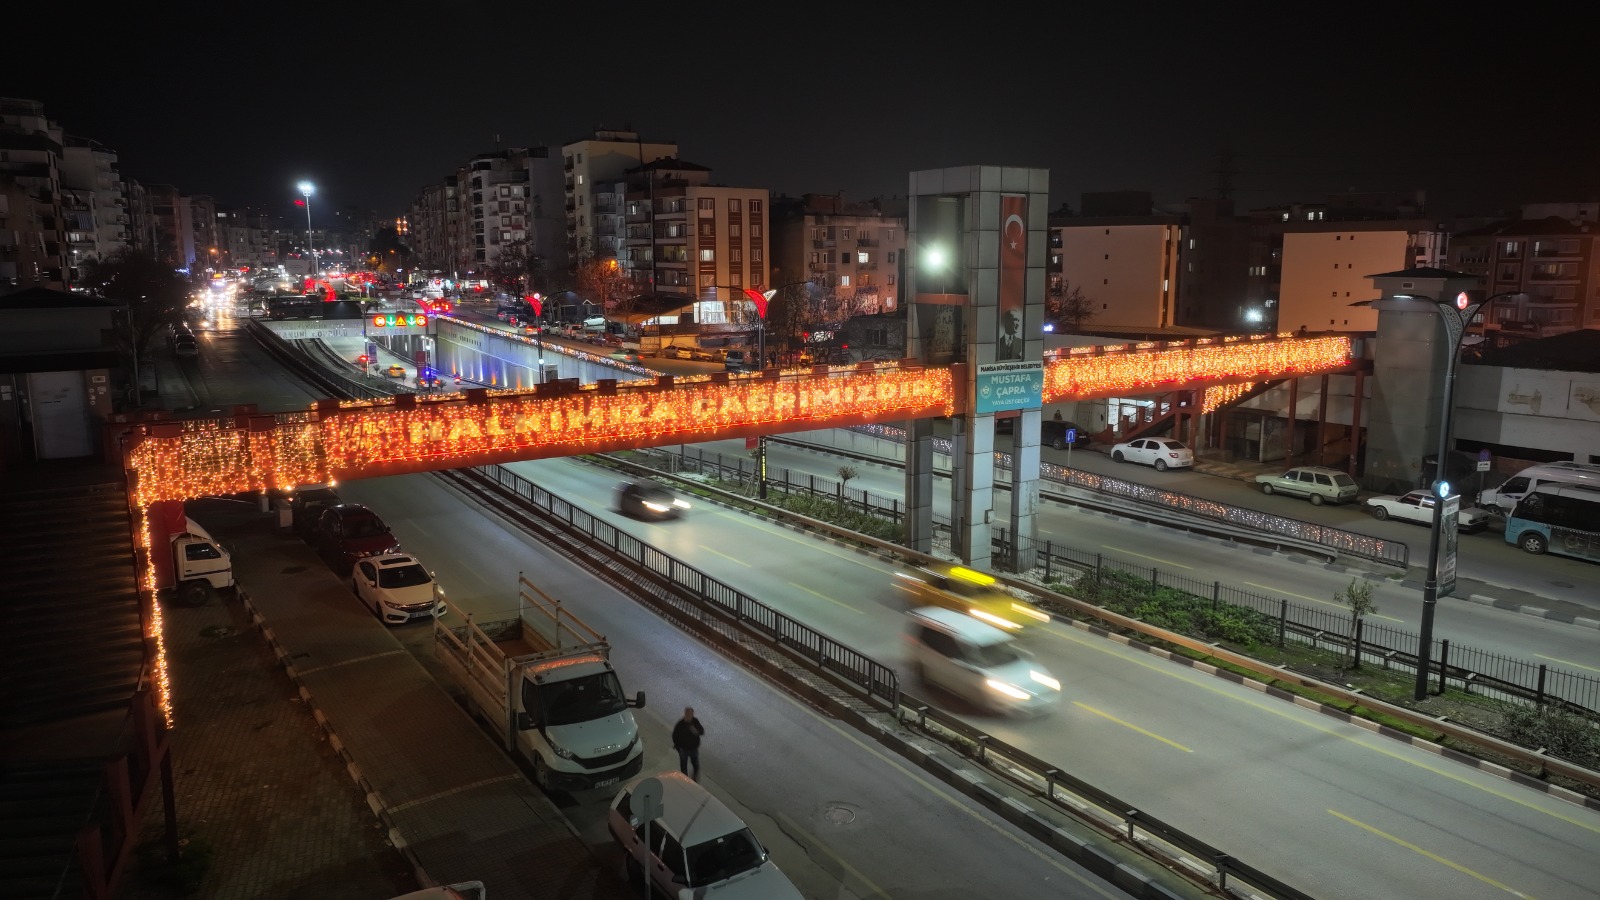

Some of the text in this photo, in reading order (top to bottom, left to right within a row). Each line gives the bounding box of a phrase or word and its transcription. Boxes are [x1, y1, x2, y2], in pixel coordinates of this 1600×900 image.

[992, 374, 1031, 384] MUSTAFA
[997, 386, 1025, 398] ÇAPRA
[409, 402, 680, 443] HALKIMIZA
